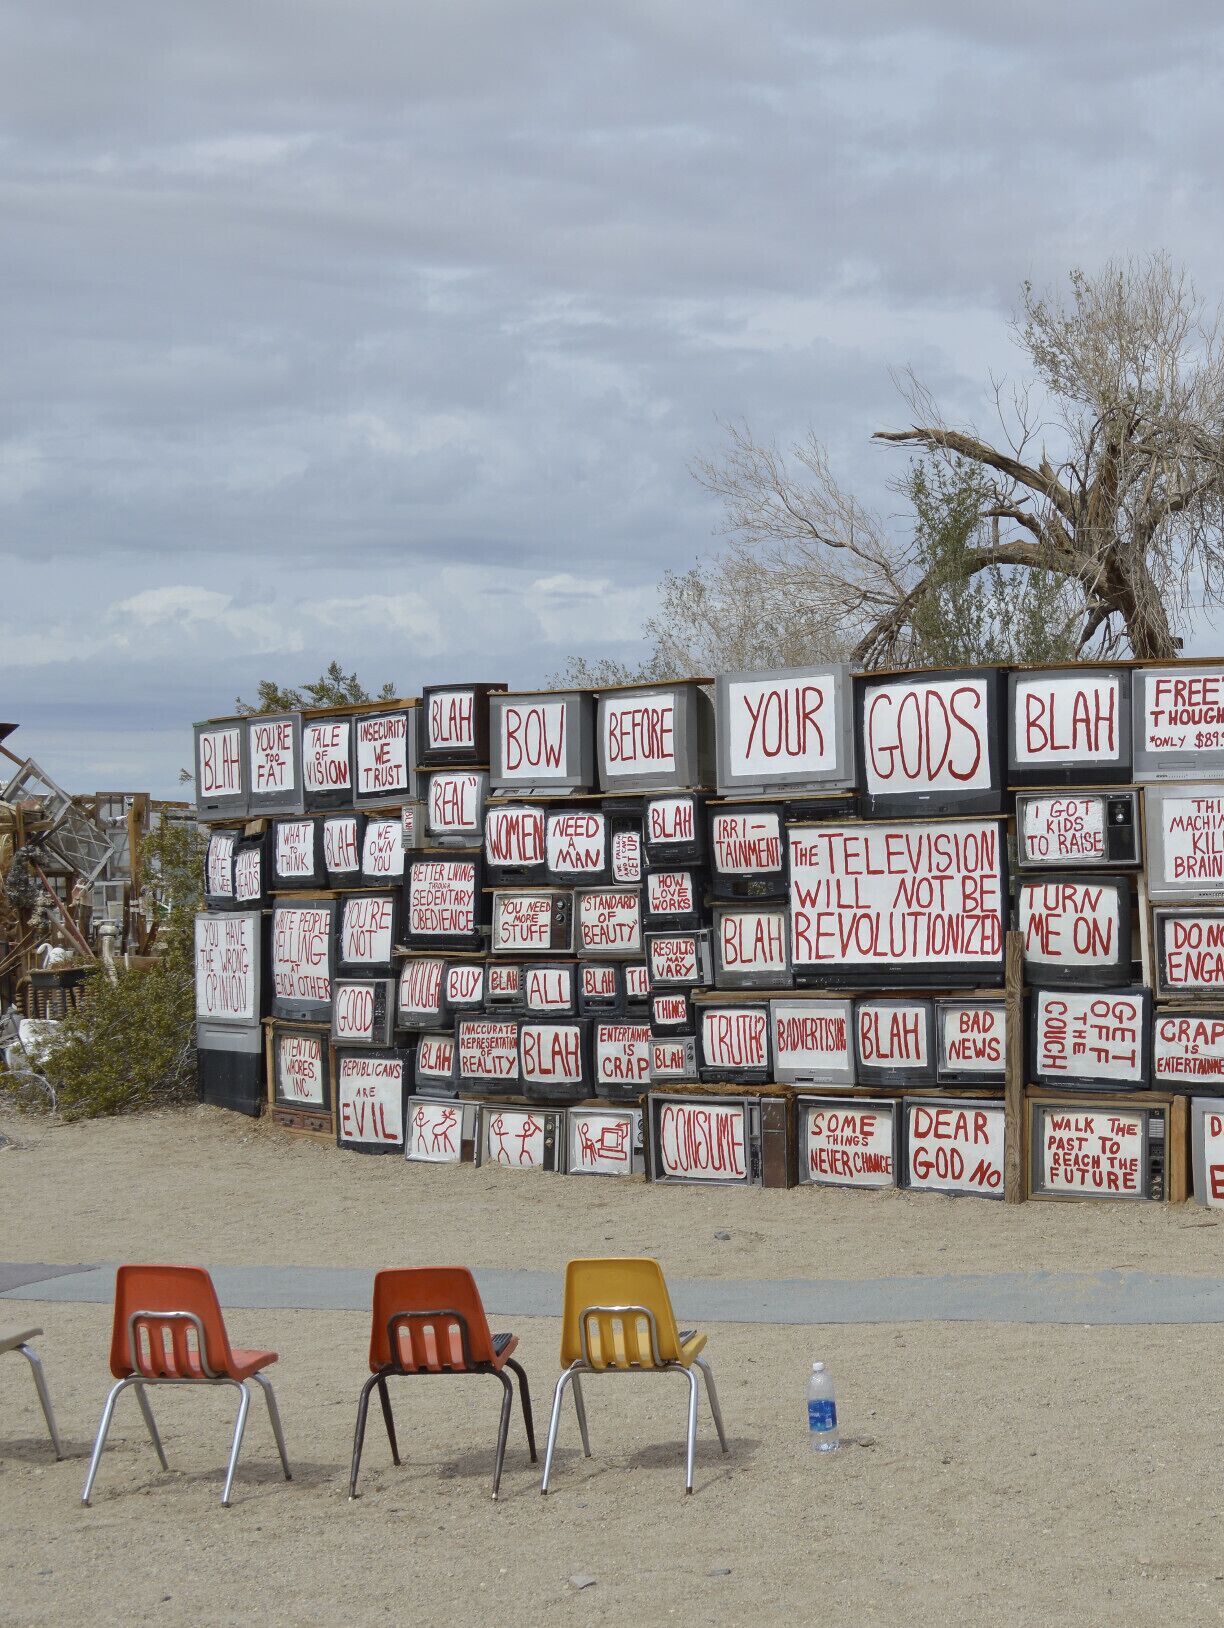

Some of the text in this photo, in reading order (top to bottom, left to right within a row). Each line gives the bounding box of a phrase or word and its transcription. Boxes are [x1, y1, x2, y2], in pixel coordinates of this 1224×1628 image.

[743, 686, 824, 759] YOUR
[608, 707, 674, 762] BEFORE
[204, 729, 241, 791] BLAH
[265, 753, 280, 762] TOO
[315, 751, 328, 761] OF
[306, 760, 348, 785] VISION
[433, 776, 477, 826] "REAL"
[1035, 800, 1095, 818] I GOT
[377, 826, 391, 840] WE
[553, 816, 600, 838] NEED
[718, 817, 766, 839] IRRI-
[1046, 817, 1084, 834] KIDS
[289, 845, 298, 854] TO
[369, 840, 395, 855] OWN
[568, 837, 577, 850] A
[791, 830, 995, 875] THE TELEVISION
[1027, 832, 1104, 856] TO RAISE
[373, 855, 391, 872] YOU
[627, 836, 639, 876] GET UP
[413, 863, 475, 882] BETTER LIVING
[658, 874, 685, 889] HOW
[582, 895, 639, 912] "STANDARD"
[652, 888, 688, 900] LOVE
[1023, 884, 1103, 914] TURN
[501, 901, 551, 915] YOU NEED
[652, 898, 691, 912] WORKS
[345, 900, 391, 930] YOU'RE
[513, 913, 539, 924] MORE
[598, 911, 617, 924] OF
[581, 919, 638, 946] "BEAUTY"
[723, 917, 784, 965] BLAH
[795, 911, 1002, 960] REVOLUTIONIZED
[1174, 921, 1202, 949] DO
[653, 940, 695, 957] RESULTS
[200, 948, 249, 974] THE WRONG
[291, 964, 300, 974] AT
[665, 956, 686, 964] MAY
[656, 963, 695, 978] VARY
[450, 971, 482, 999] BUY
[491, 970, 518, 991] BLAH
[461, 1023, 517, 1036] INACCURATE
[960, 1011, 995, 1034] BAD
[706, 1014, 765, 1065] TRUTH?
[1072, 1012, 1087, 1055] THE
[1111, 1001, 1136, 1068] GET
[420, 1043, 454, 1072] BLAH
[481, 1049, 493, 1057] OF
[623, 1044, 635, 1056] IS
[1184, 1044, 1199, 1054] IS
[462, 1056, 516, 1075] REALITY
[355, 1086, 376, 1098] ARE
[811, 1113, 878, 1137] SOME
[913, 1107, 990, 1145] DEAR
[1050, 1114, 1138, 1137] WALK THE
[826, 1134, 868, 1147] THINGS
[1048, 1136, 1120, 1155] PAST TO
[1053, 1152, 1138, 1172] REACH THE
